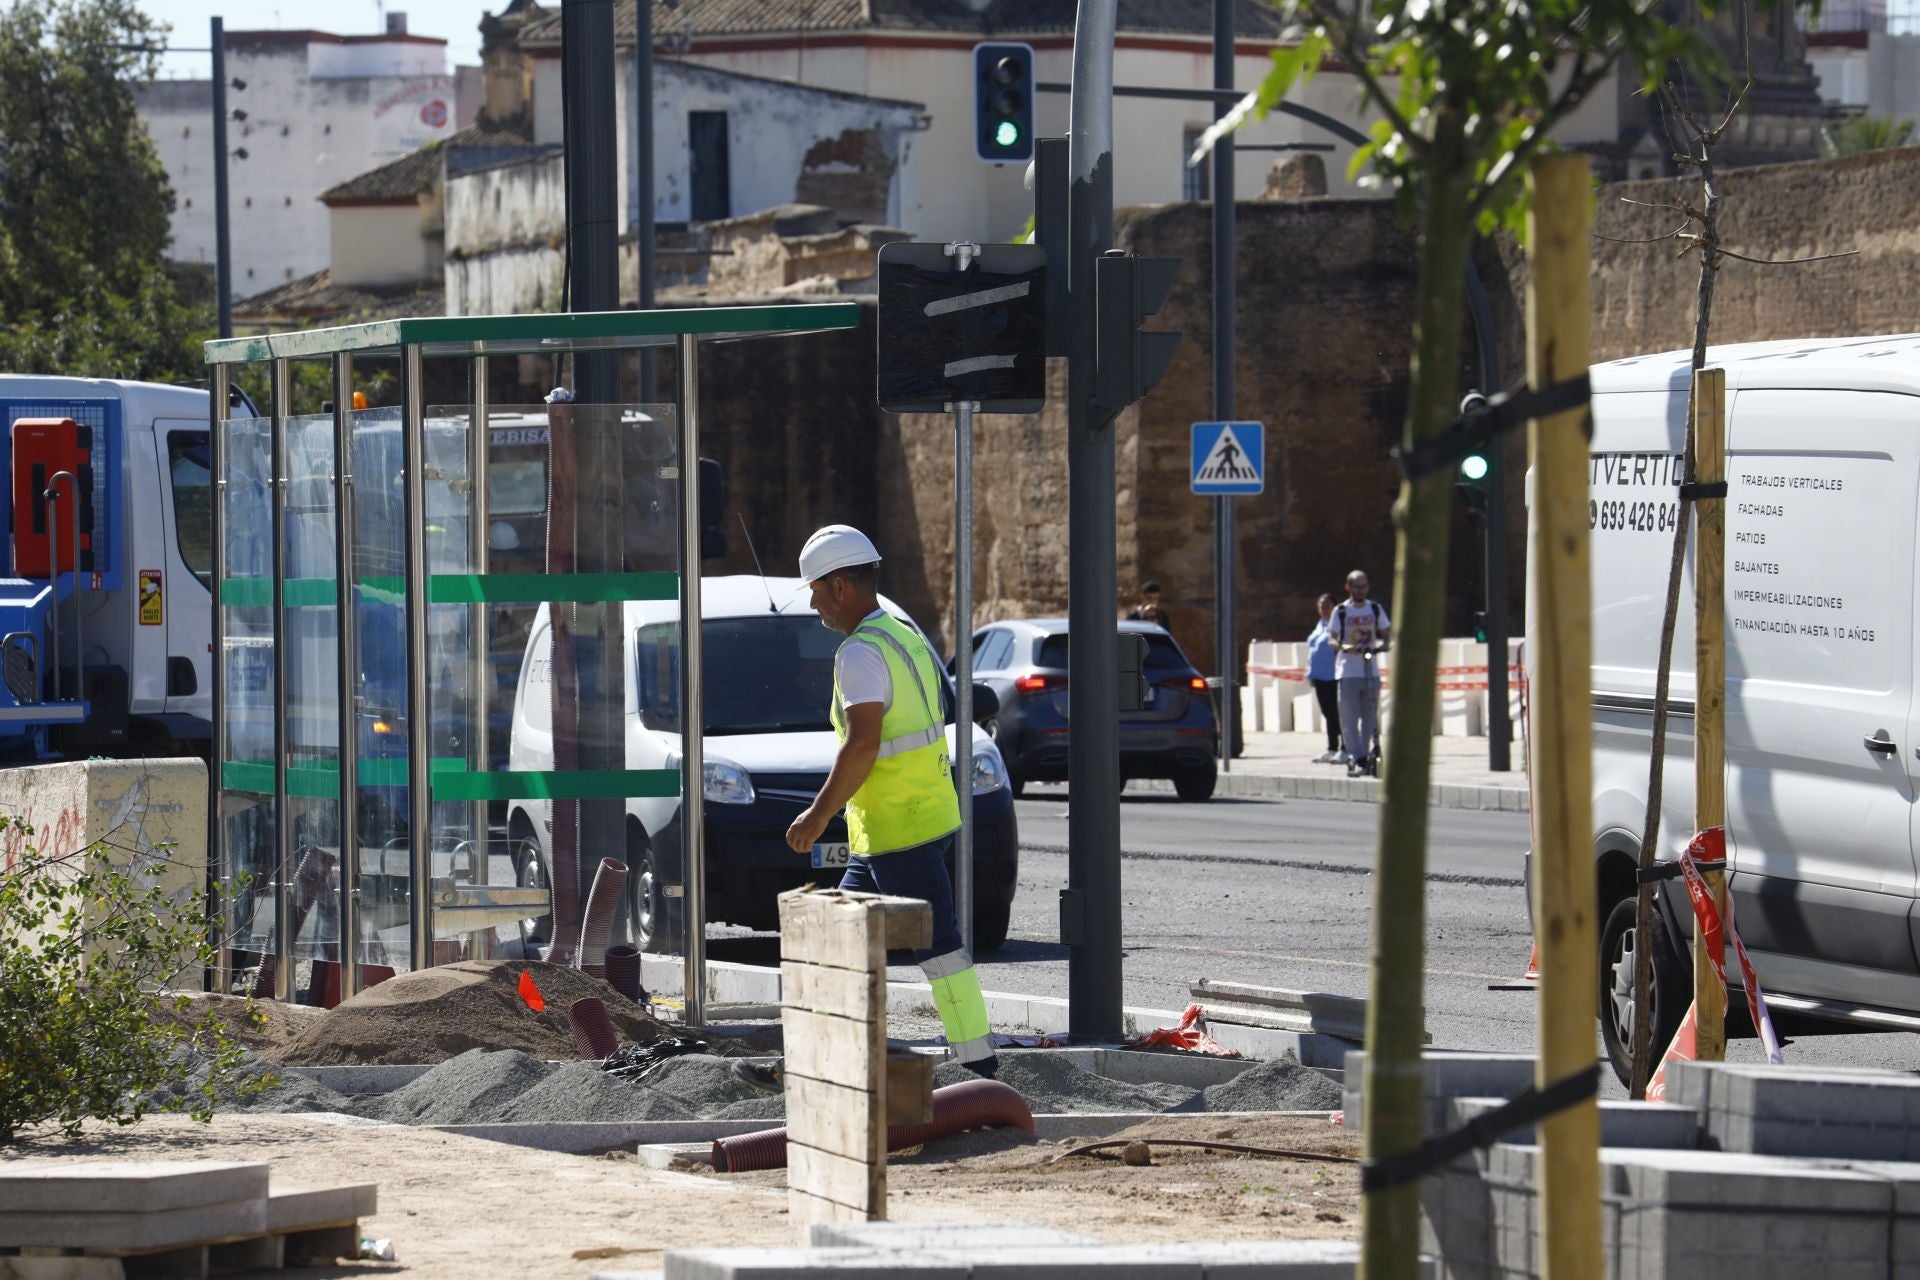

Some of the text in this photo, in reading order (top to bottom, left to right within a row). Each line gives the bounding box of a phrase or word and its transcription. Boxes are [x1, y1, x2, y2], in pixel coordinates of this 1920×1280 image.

[490, 427, 551, 446] EBISA
[1589, 453, 1683, 487] TVERTIC
[1741, 474, 1843, 491] TRABAJOS VERTICALES
[1601, 500, 1681, 533] 693 426 84
[1738, 503, 1784, 517] FACHADAS
[1736, 532, 1766, 545] PATIOS
[1734, 560, 1779, 575] BAJANTES
[1734, 589, 1843, 609] IMPERMEABILIZACIONES
[1734, 618, 1875, 642] FINANCIACIÓN HASTA 10 AÑOS
[825, 846, 849, 864] 49
